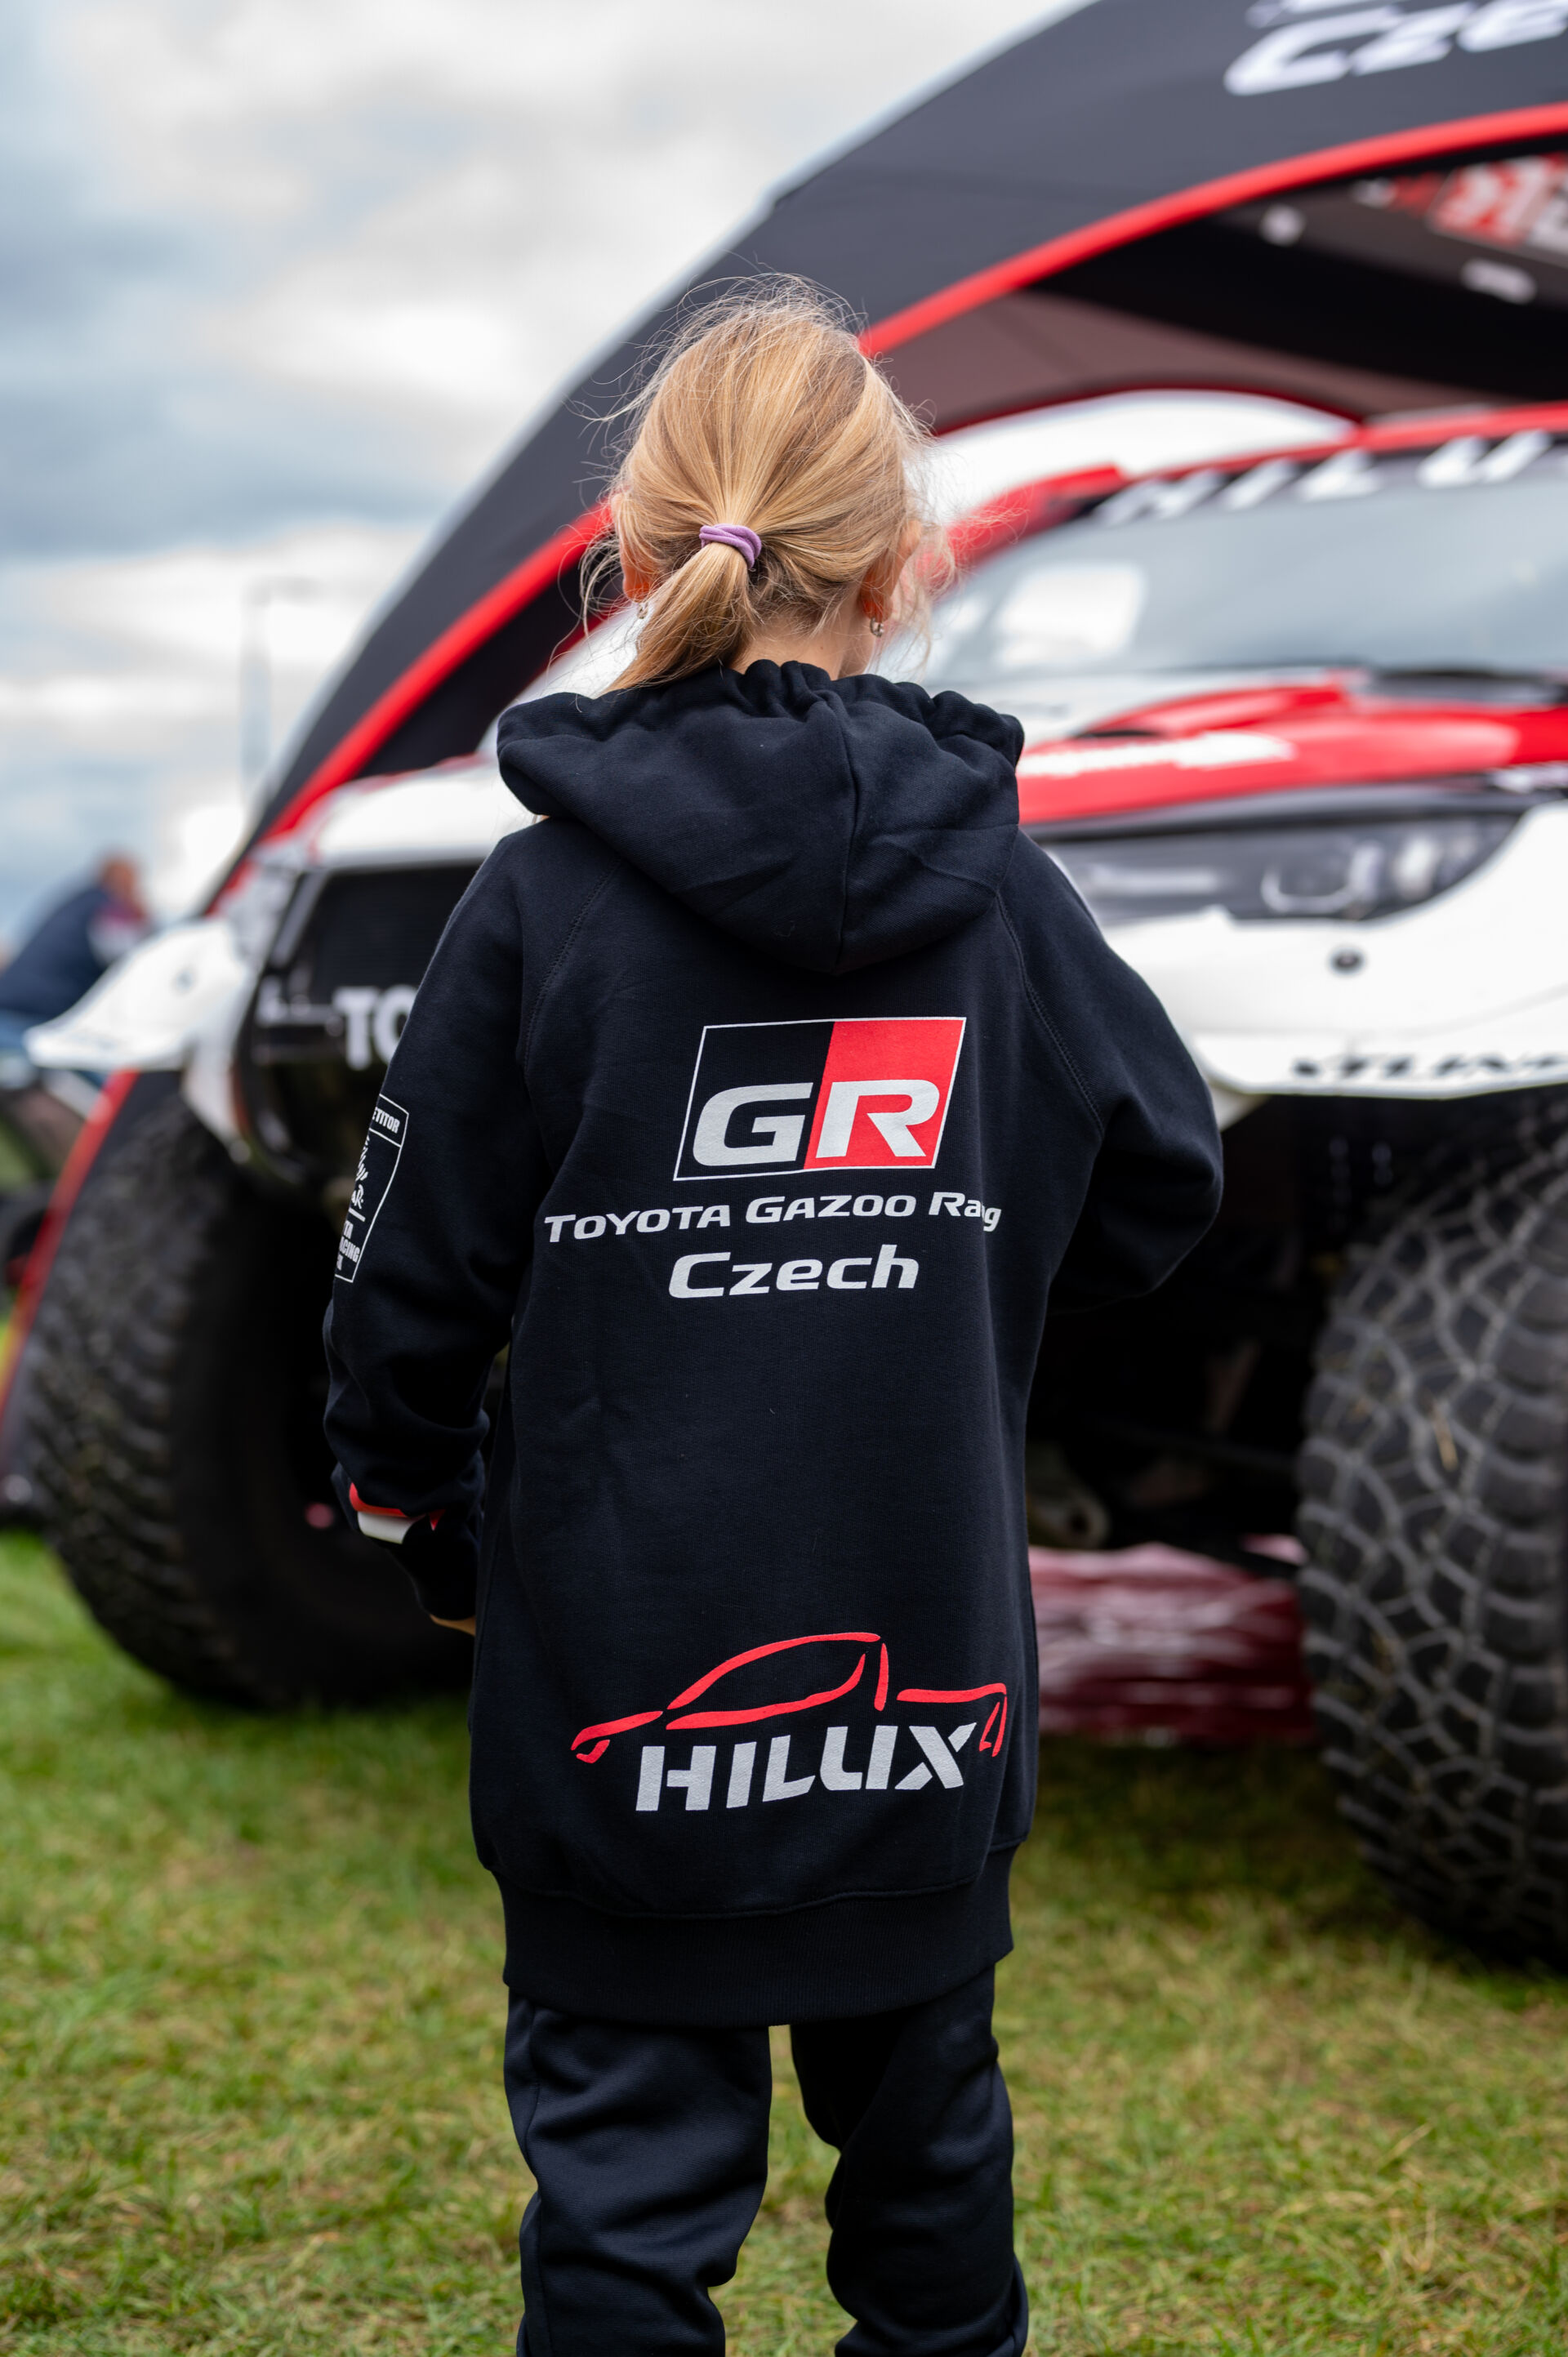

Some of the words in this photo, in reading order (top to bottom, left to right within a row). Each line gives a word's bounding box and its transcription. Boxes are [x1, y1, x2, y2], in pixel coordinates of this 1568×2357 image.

[693, 1079, 941, 1167] GR
[544, 1205, 731, 1243] TOYOTA
[745, 1194, 917, 1223] GAZOO
[668, 1244, 920, 1299] Czech
[635, 1722, 978, 1811] HILUX
